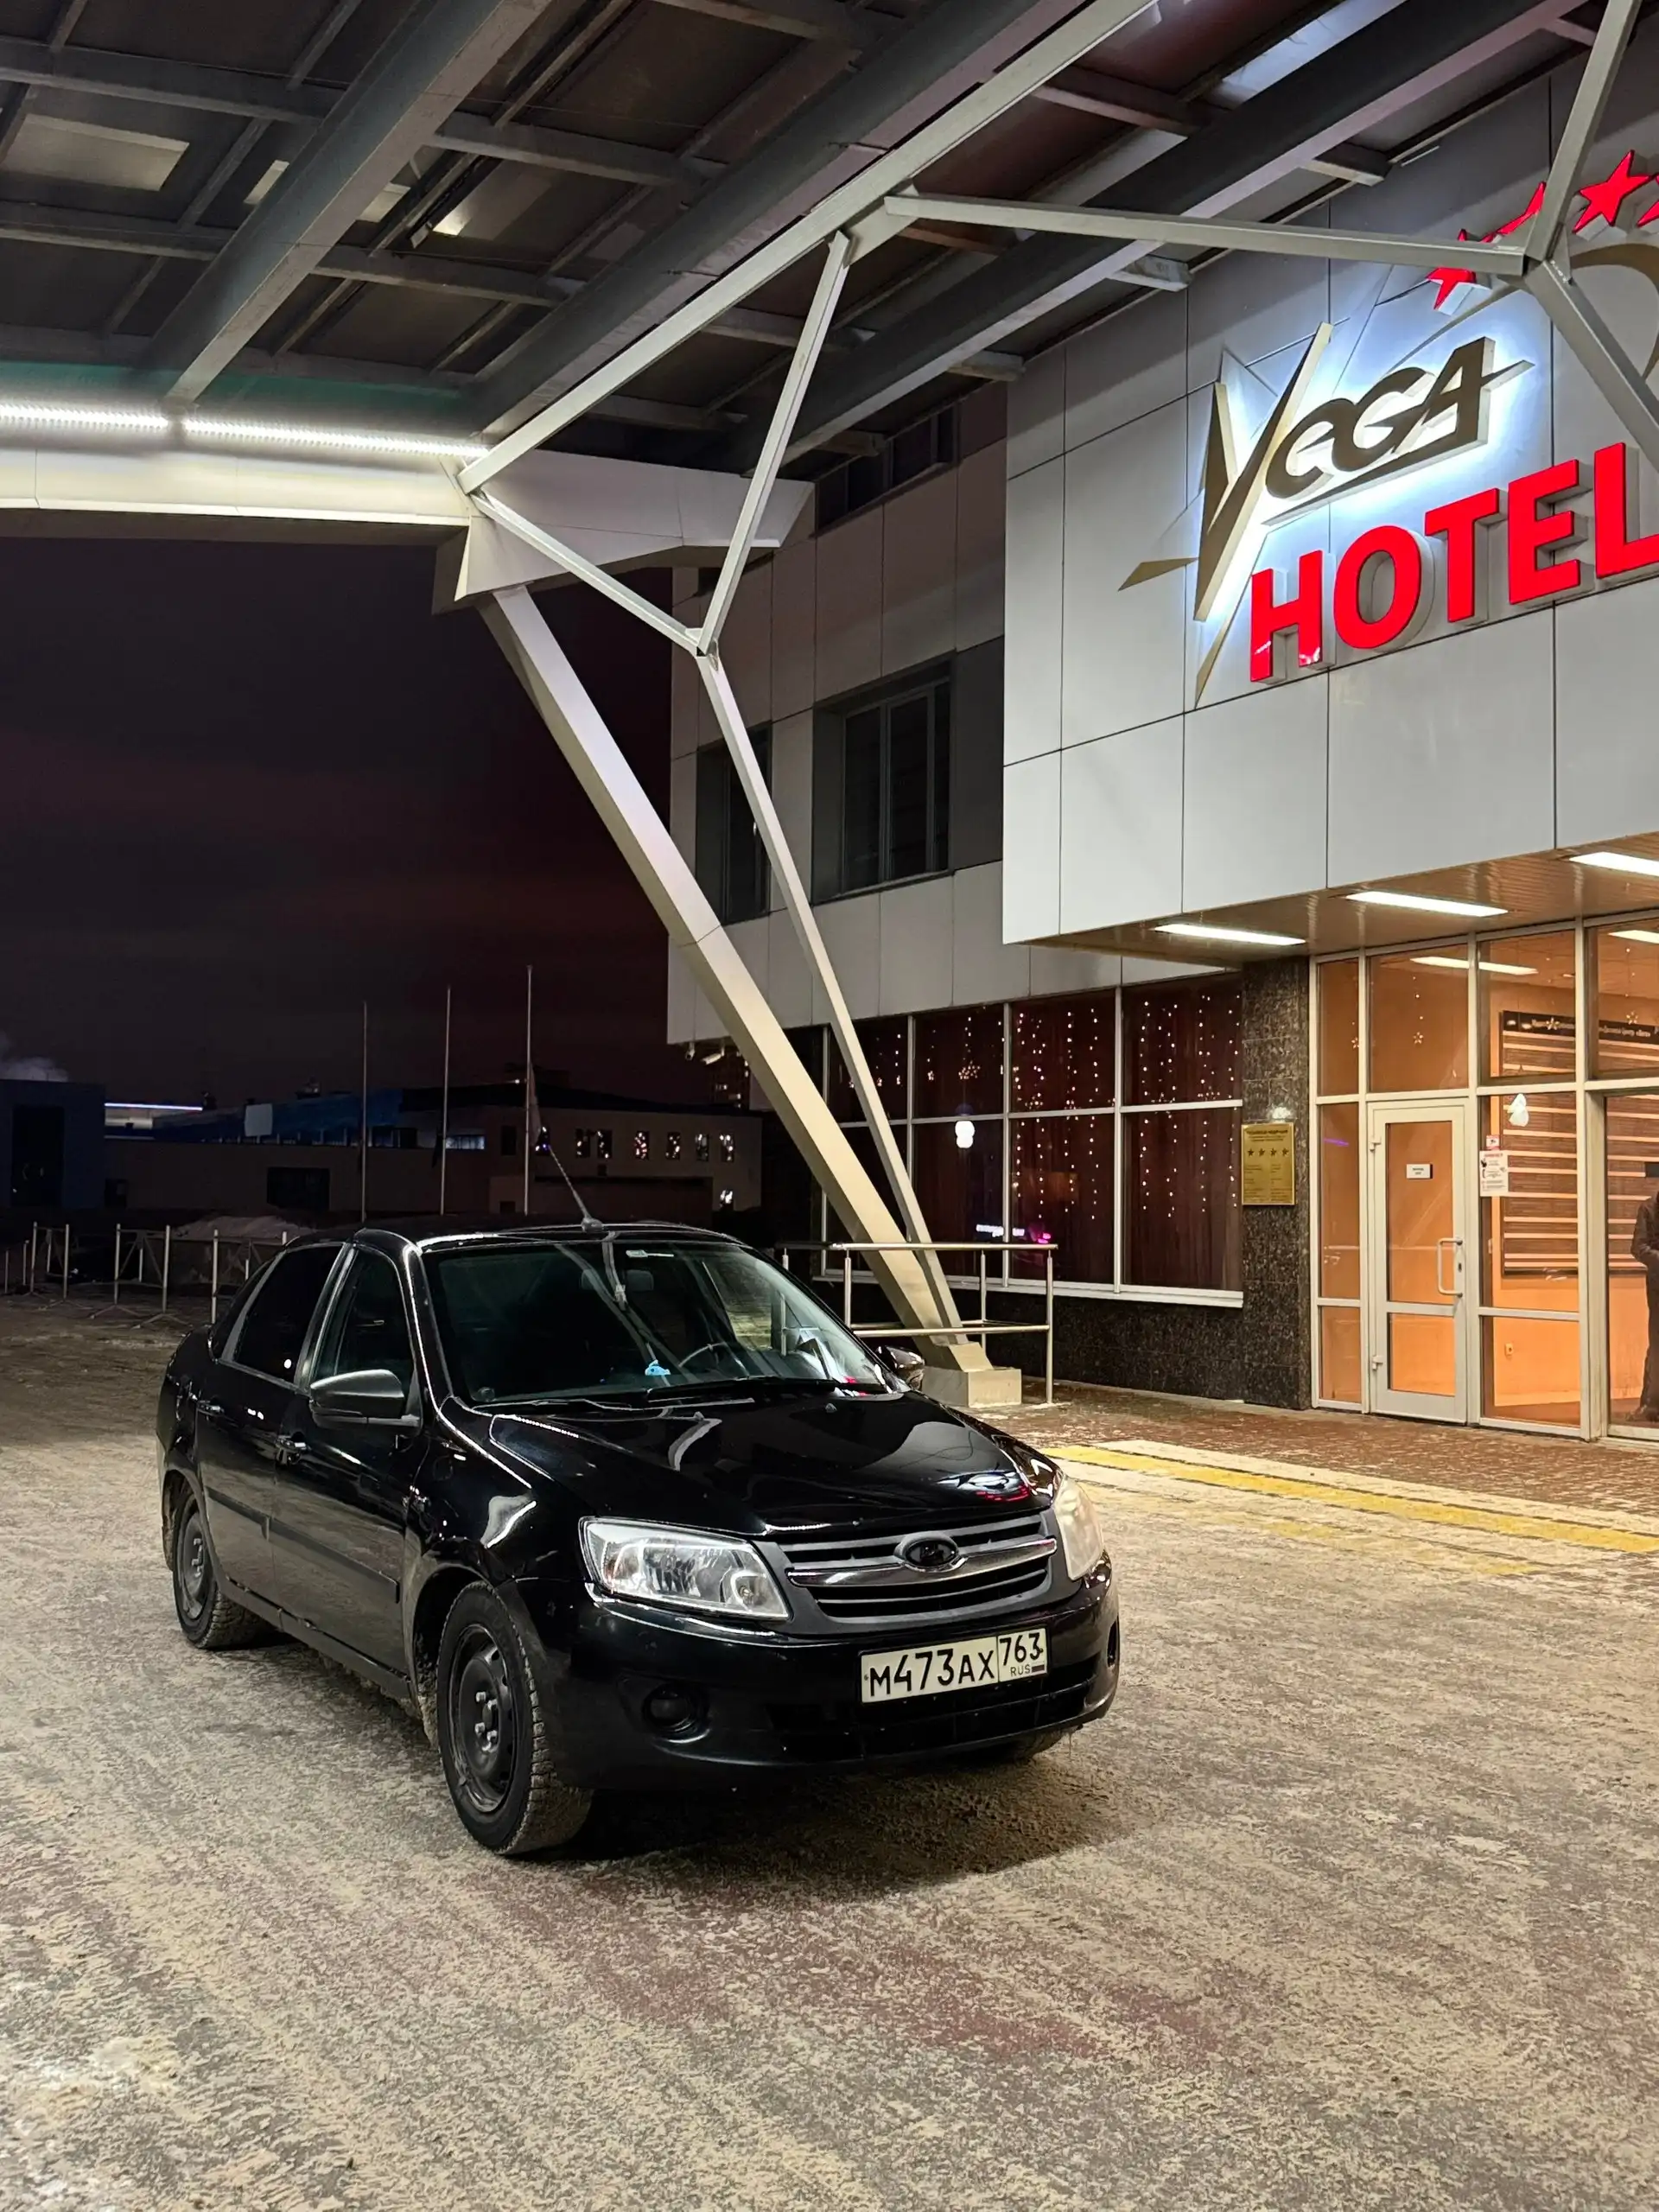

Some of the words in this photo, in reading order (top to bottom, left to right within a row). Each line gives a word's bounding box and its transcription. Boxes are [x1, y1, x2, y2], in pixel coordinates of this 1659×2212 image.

[1249, 442, 1659, 683] HOTEL
[999, 1631, 1042, 1667] 763
[1010, 1663, 1031, 1677] RUS
